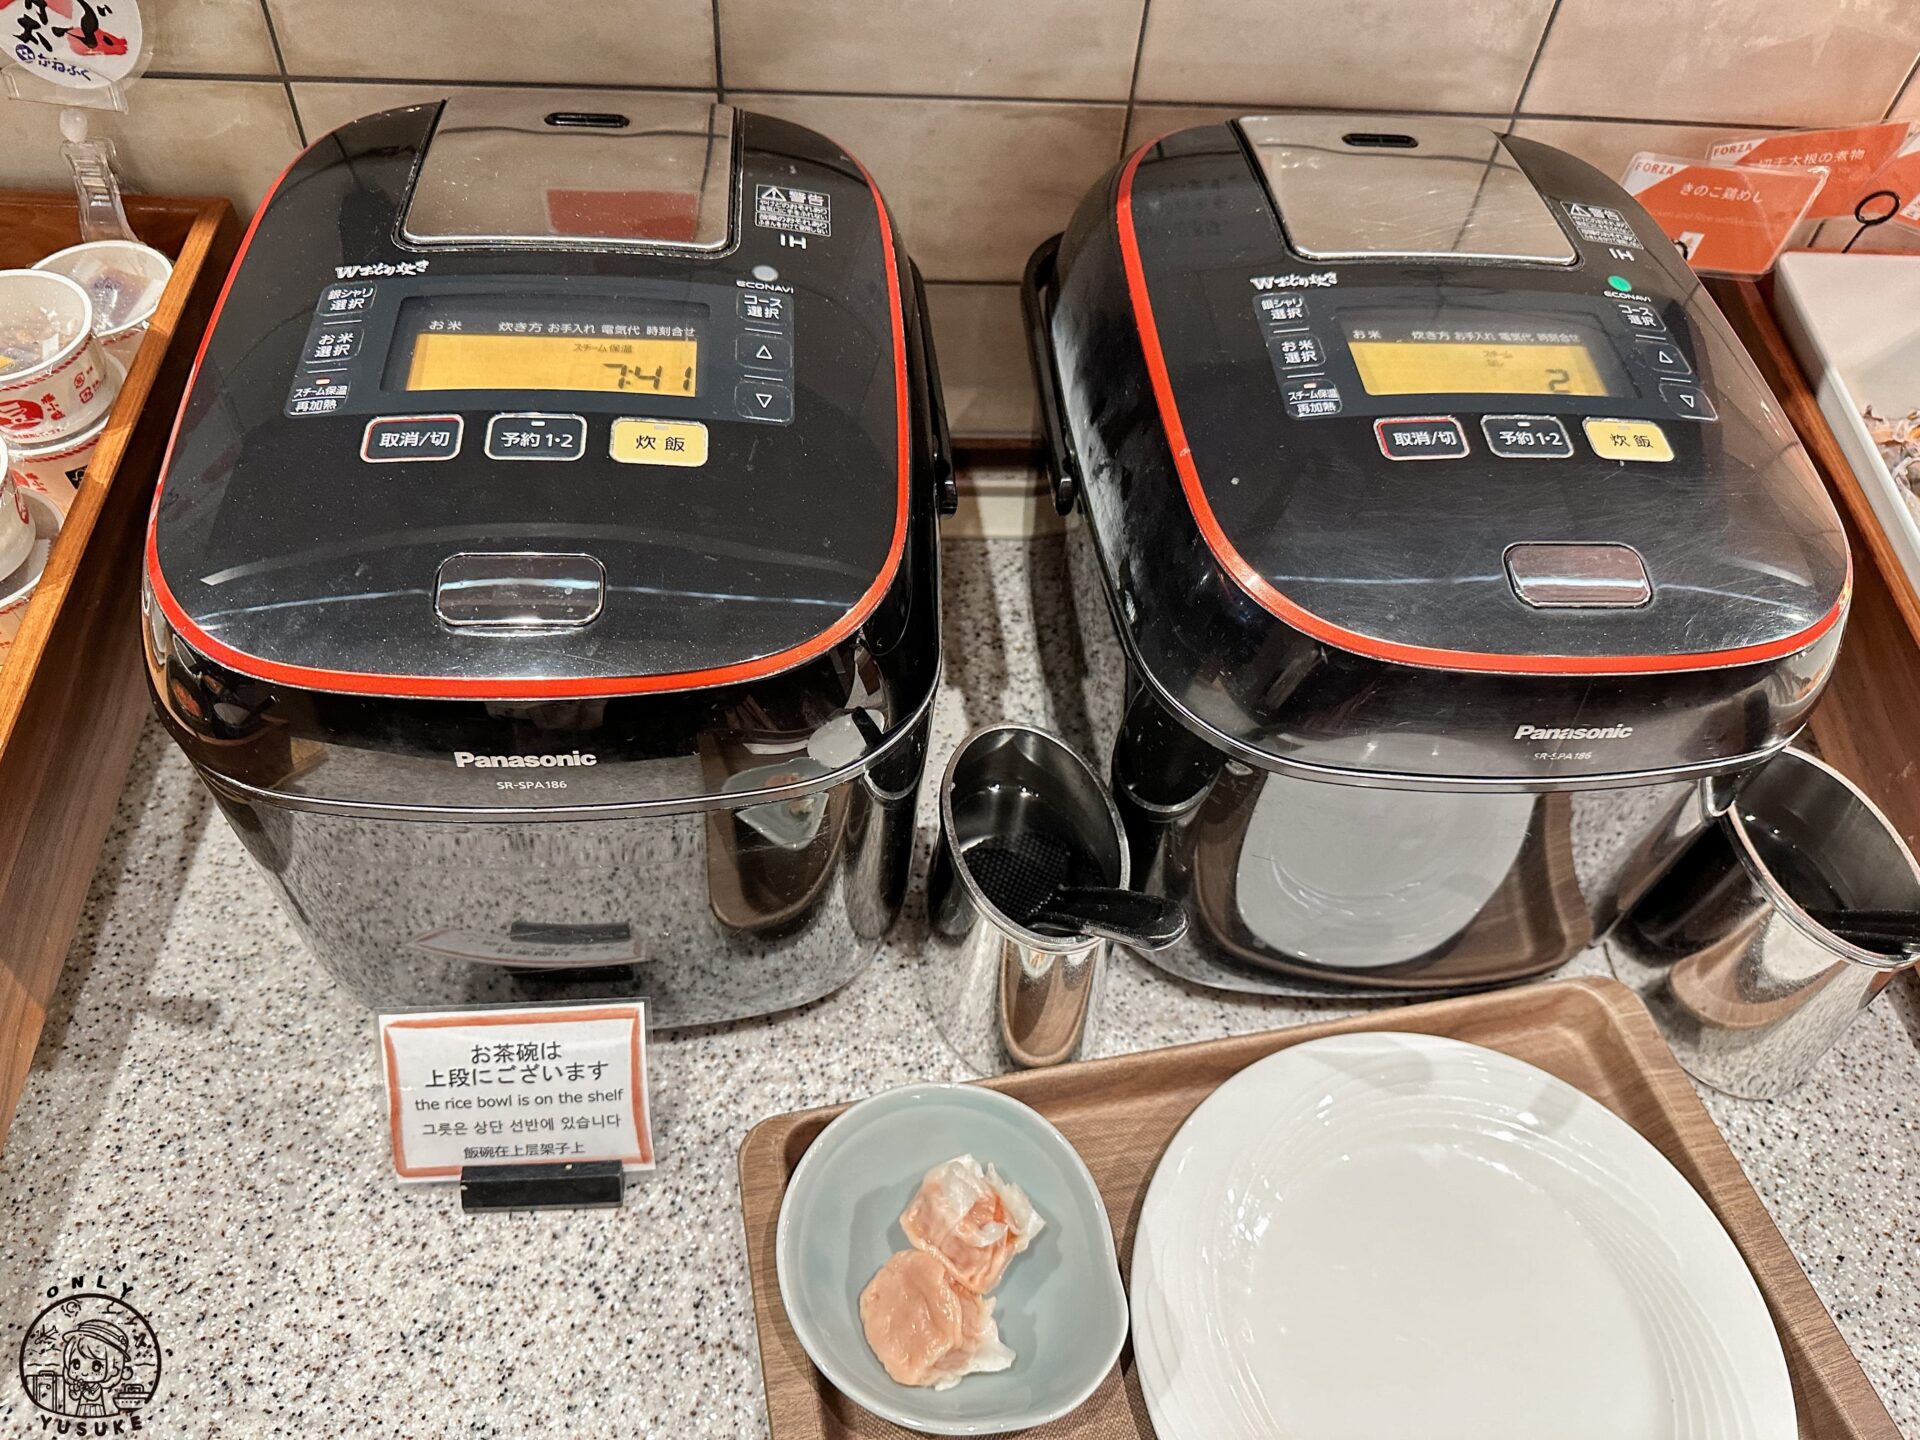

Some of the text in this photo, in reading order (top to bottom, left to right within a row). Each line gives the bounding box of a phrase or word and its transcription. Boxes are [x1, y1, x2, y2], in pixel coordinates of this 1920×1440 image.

[38, 53, 91, 81] かねふく
[1713, 143, 1752, 156] FORZA
[1634, 161, 1675, 175] FORZA
[780, 233, 807, 249] IH
[1609, 248, 1635, 262] IH
[327, 287, 374, 300] 銀シャリ
[736, 280, 794, 294] ECONAVI
[744, 294, 783, 309] コース
[1603, 290, 1652, 302] ECONAVI
[330, 298, 365, 311] 選択
[1261, 297, 1303, 310] 銀シャリ
[1618, 304, 1653, 317] コース
[747, 305, 780, 319] 選択
[1271, 307, 1303, 320] 選択
[429, 320, 696, 338] お米 炊き方 お手入れ 電気代 時刻合せ
[1411, 330, 1450, 341] 炊き方
[318, 333, 354, 345] お米
[1281, 338, 1315, 352] お米
[314, 344, 350, 358] 選択
[1284, 351, 1318, 364] 選択
[1546, 369, 1571, 393] 2
[293, 385, 348, 399] スチーム保温
[1287, 388, 1339, 401] スチーム保温
[295, 399, 337, 412] 再加熱
[1296, 401, 1337, 414] 再加熱
[378, 431, 450, 449] 取消/切
[1393, 431, 1456, 446] 取消/切
[1513, 723, 1633, 740] Panasonic
[453, 750, 598, 768] Panasonic
[1533, 752, 1593, 760] SR-SPA186
[496, 781, 568, 790] SR-SPA186
[471, 1041, 562, 1064] お茶碗は
[425, 1060, 609, 1088] 上段にございます
[415, 1089, 624, 1111] the rice bowl is on the shelf
[422, 1114, 621, 1136] 그릇은 상단 선반에 있습니다
